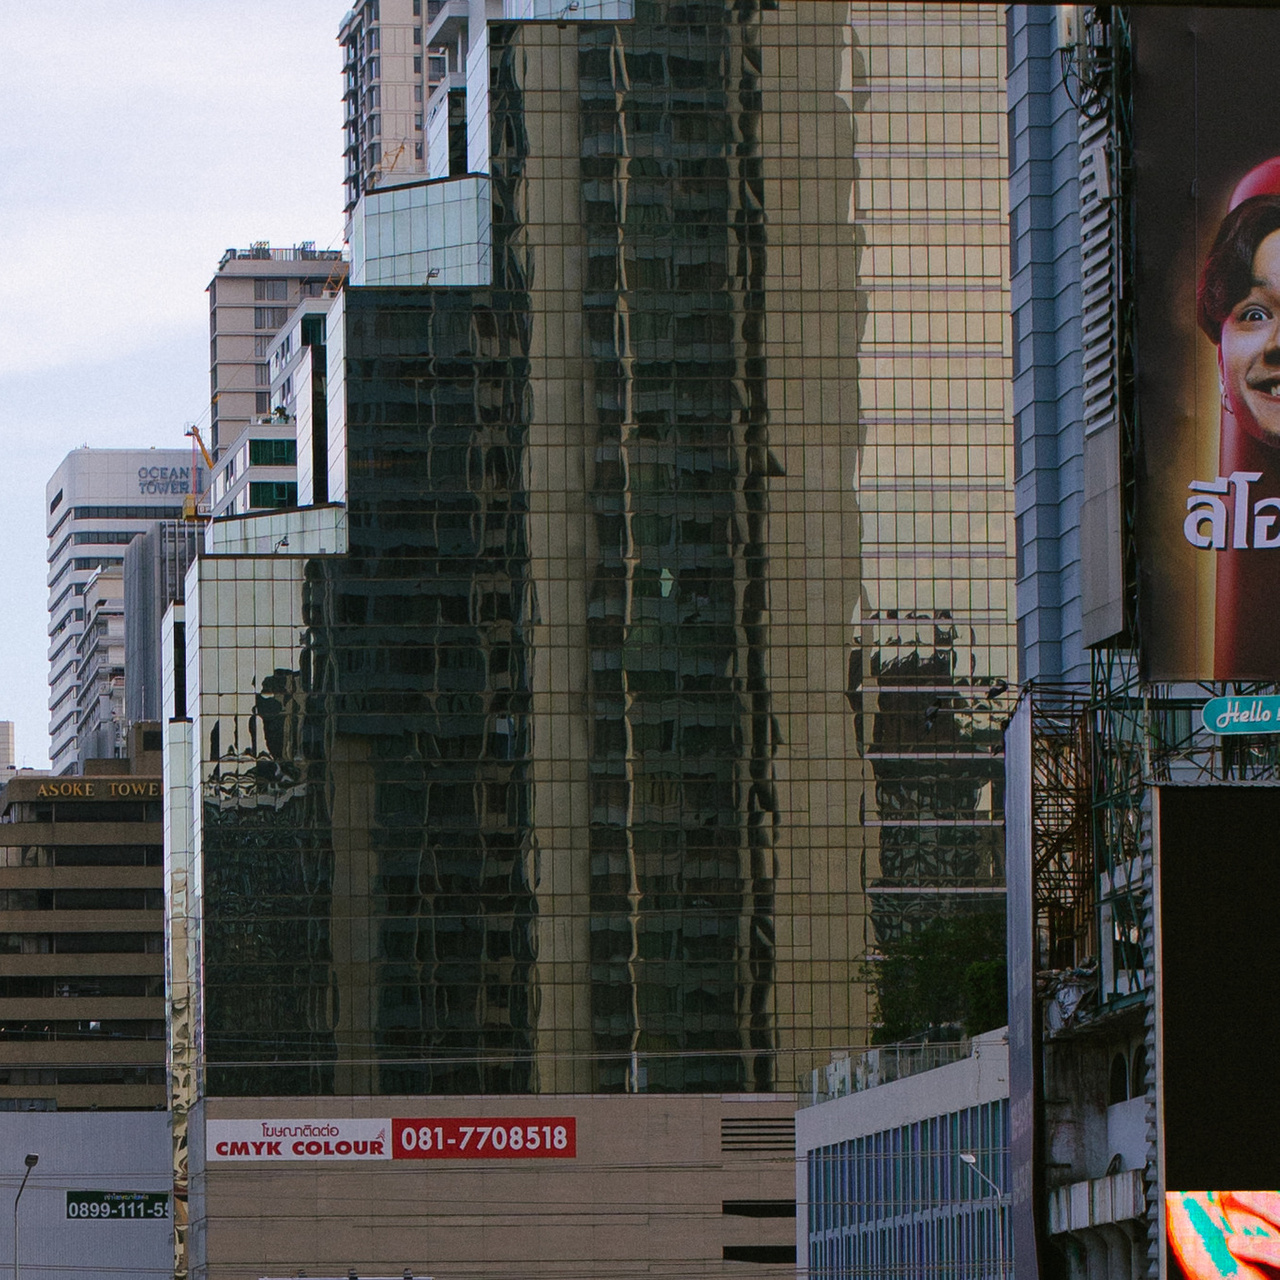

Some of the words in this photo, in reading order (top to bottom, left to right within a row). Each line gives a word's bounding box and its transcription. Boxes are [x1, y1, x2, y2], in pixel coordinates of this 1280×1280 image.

[138, 466, 190, 479] OCEAN
[138, 481, 190, 495] TOWER
[1215, 699, 1272, 728] Hello
[37, 782, 96, 797] ASOKE
[107, 782, 164, 797] TOWE
[400, 1126, 568, 1151] 081-7708518
[215, 1141, 283, 1156] CMYK
[291, 1140, 384, 1156] COLOUR
